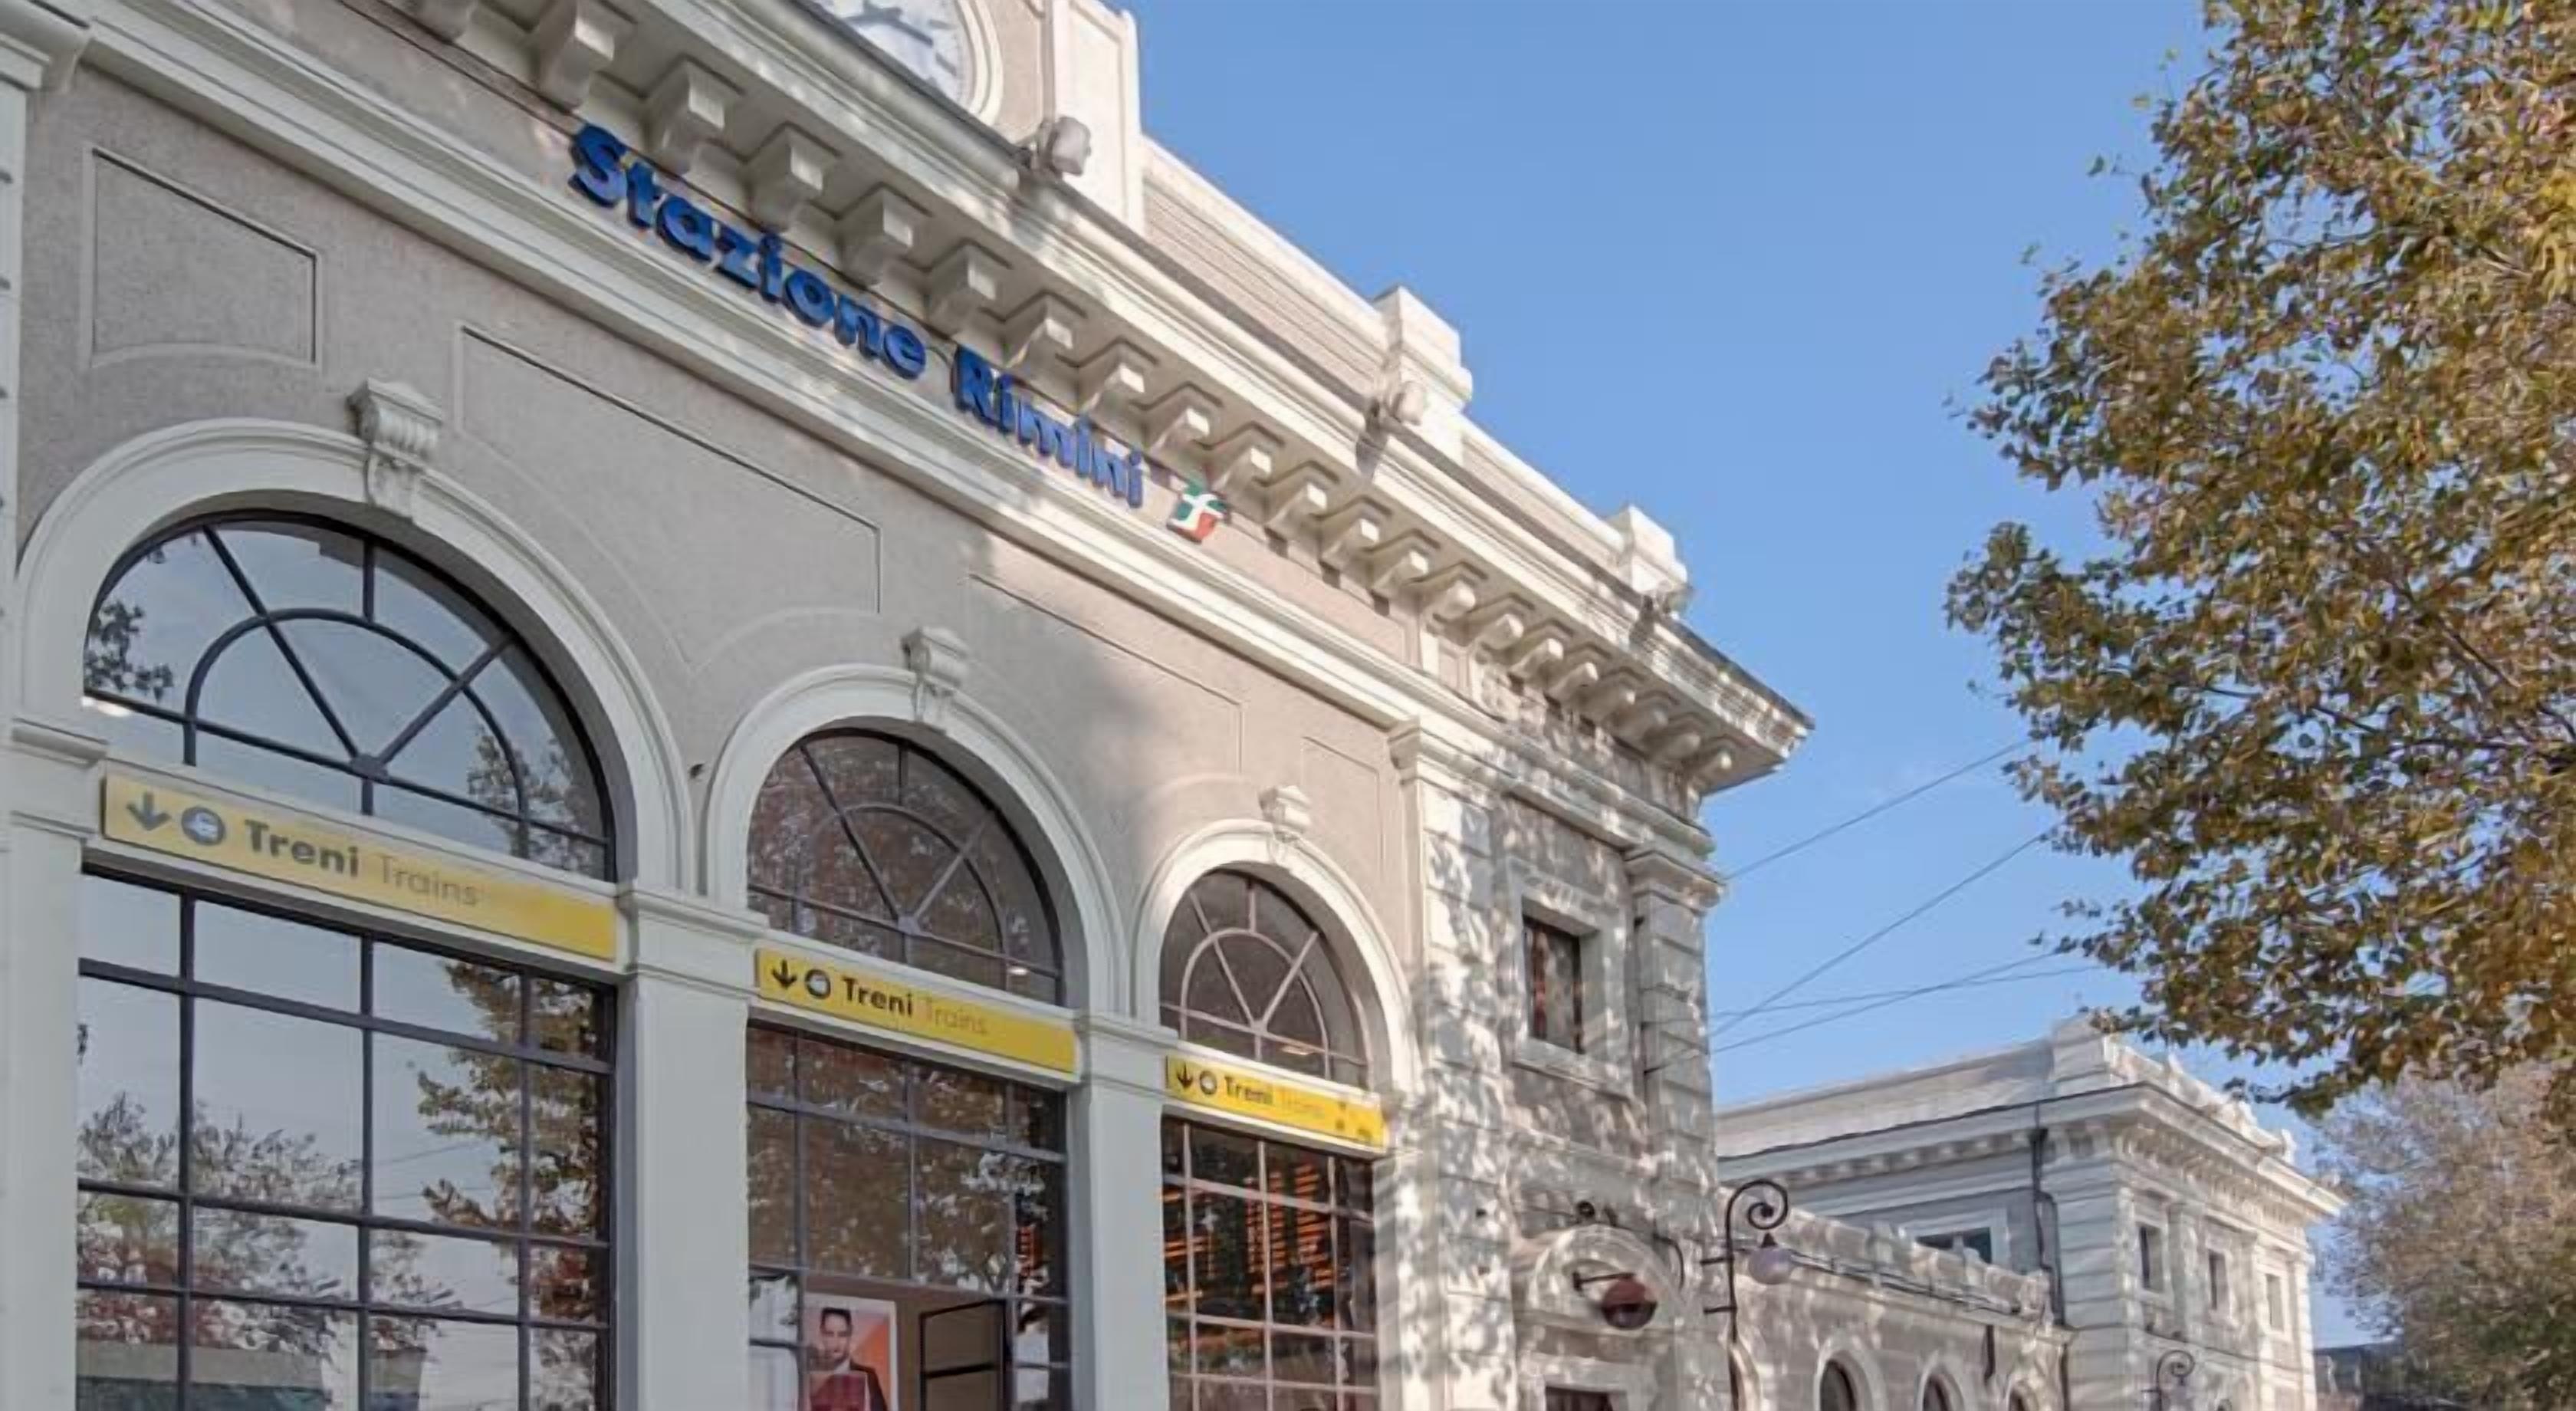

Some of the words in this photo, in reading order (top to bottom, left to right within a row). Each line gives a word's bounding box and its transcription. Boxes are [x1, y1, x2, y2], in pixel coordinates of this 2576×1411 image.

[568, 123, 926, 380] Stazione
[951, 344, 1142, 508] Rimini
[243, 818, 360, 877] Treni
[376, 854, 477, 906] Trains
[841, 977, 913, 1017] Treni
